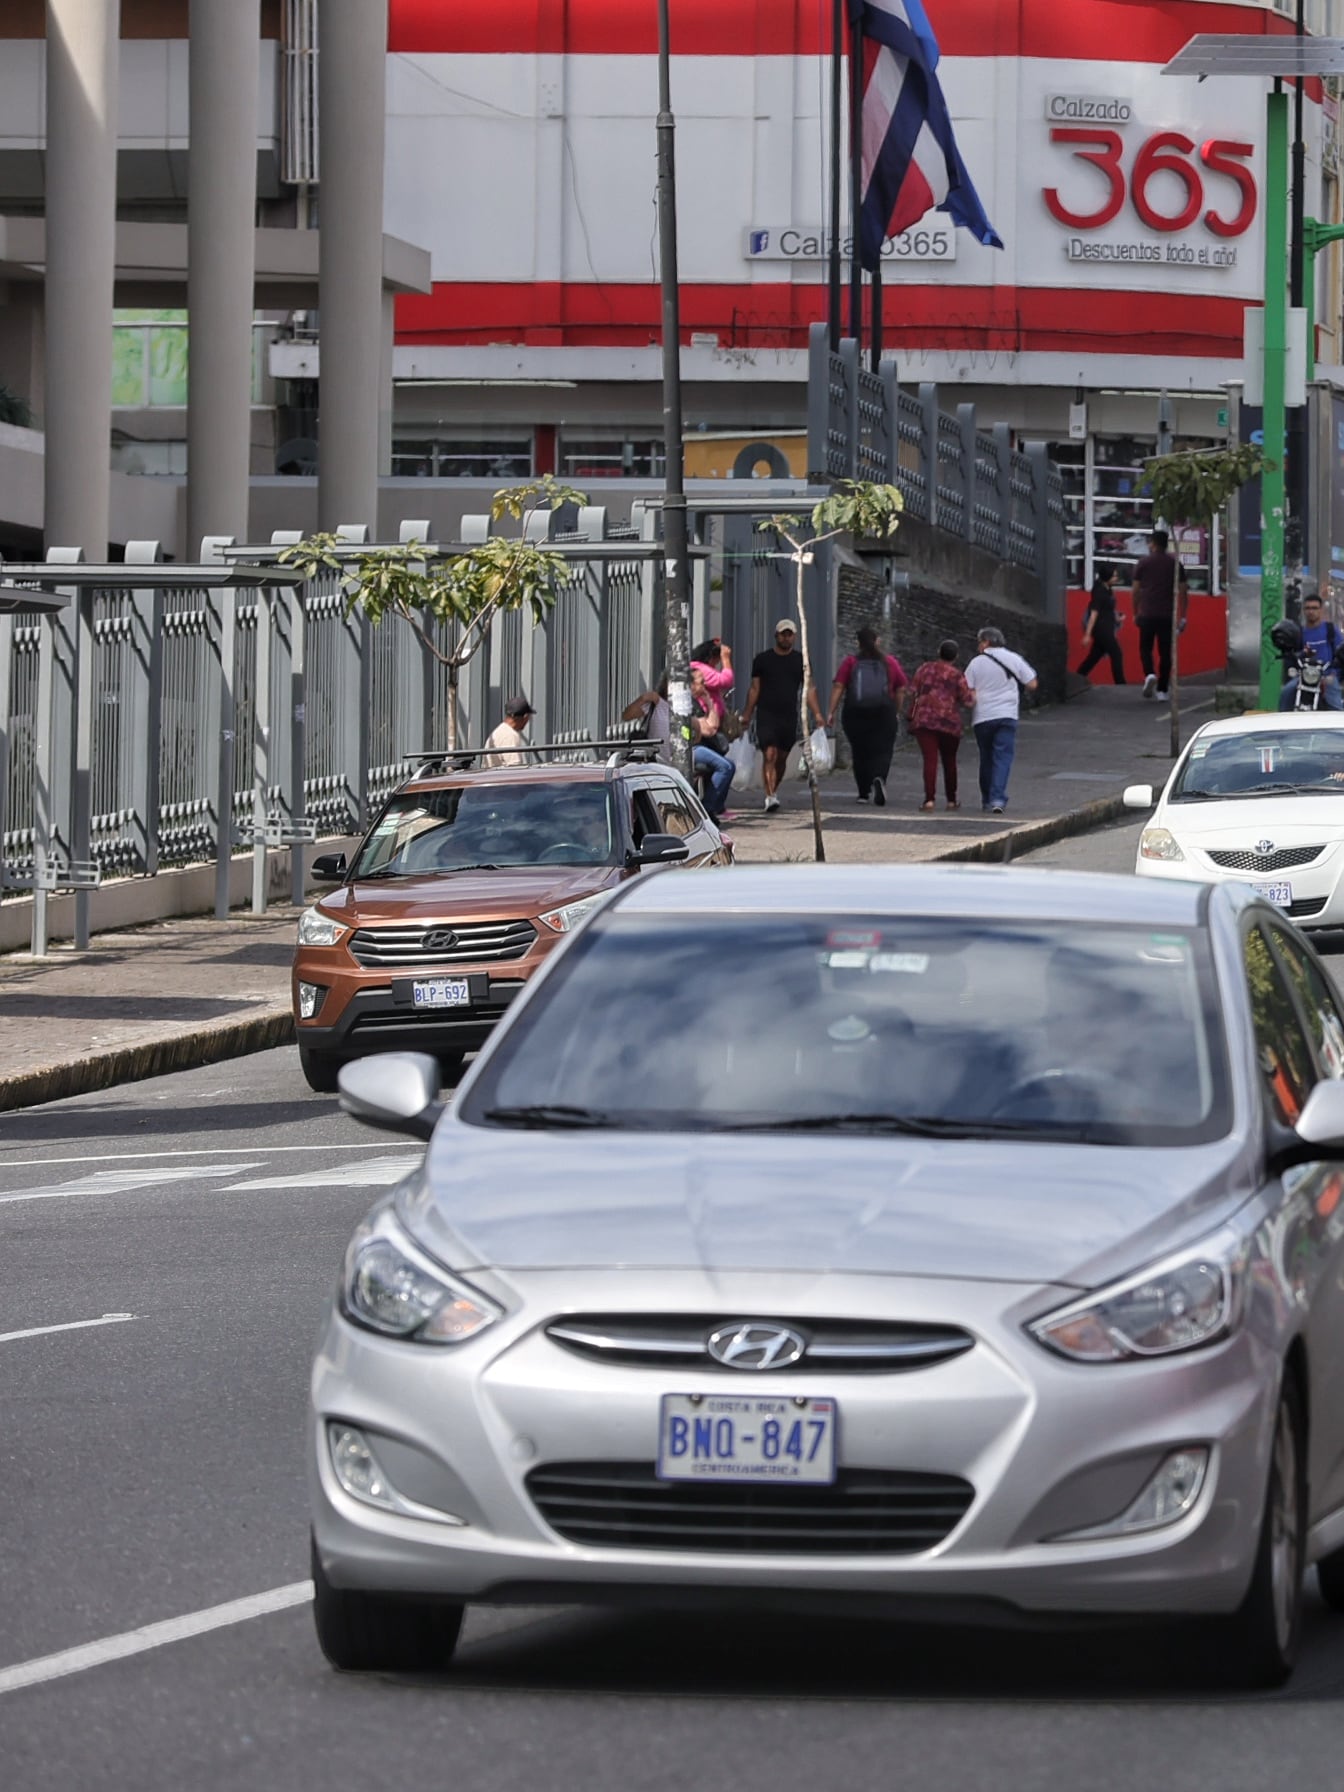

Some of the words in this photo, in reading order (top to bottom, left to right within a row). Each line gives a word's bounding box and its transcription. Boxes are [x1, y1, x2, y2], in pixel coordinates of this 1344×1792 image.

[1050, 96, 1131, 120] Calzado
[1042, 127, 1258, 237] 365
[1070, 238, 1161, 261] Descuentos
[1166, 243, 1194, 263] todo
[1198, 246, 1209, 264] el
[414, 984, 467, 1003] BLP-692
